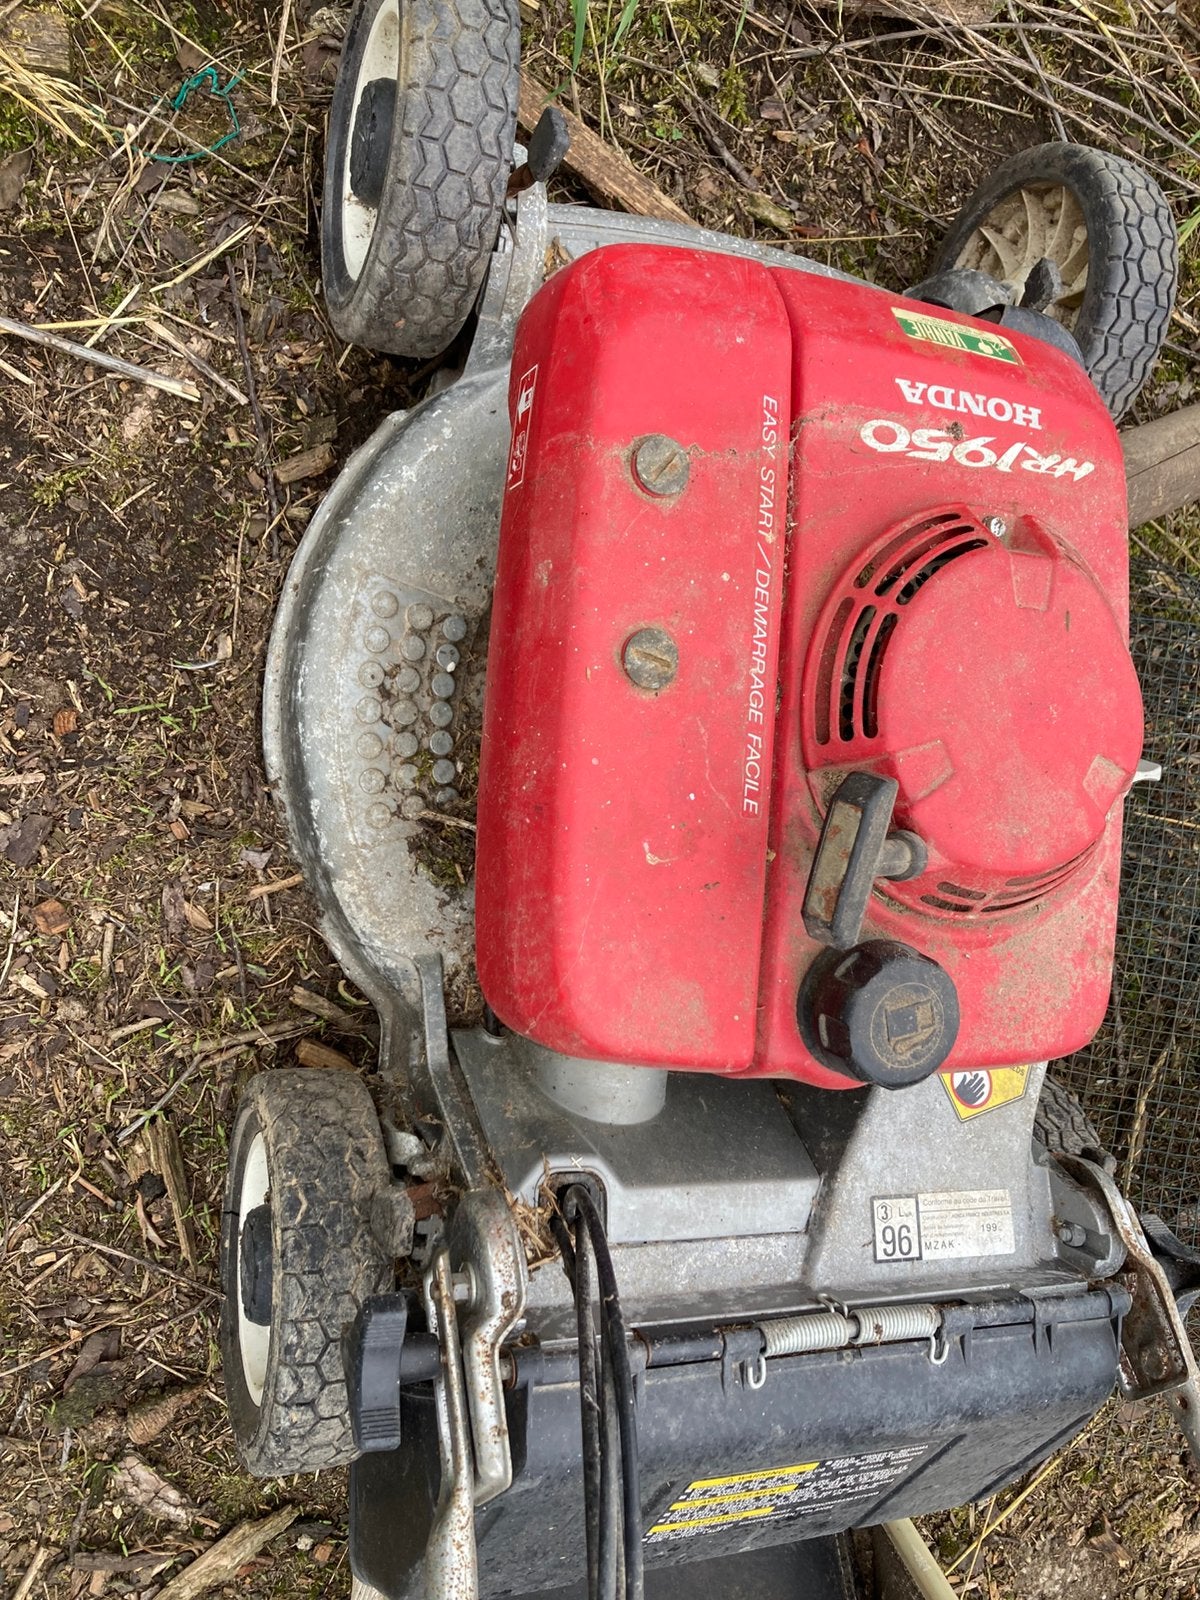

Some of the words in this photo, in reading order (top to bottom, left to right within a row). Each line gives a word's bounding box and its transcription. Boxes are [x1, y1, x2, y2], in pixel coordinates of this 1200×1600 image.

[911, 321, 968, 349] VANHIE
[762, 395, 778, 459] EASY
[895, 378, 1042, 430] HONDA
[758, 466, 775, 541] START
[748, 568, 771, 725] DEMARRAGE
[743, 732, 762, 815] FACILE
[880, 1205, 888, 1220] 3
[882, 1224, 912, 1257] 96
